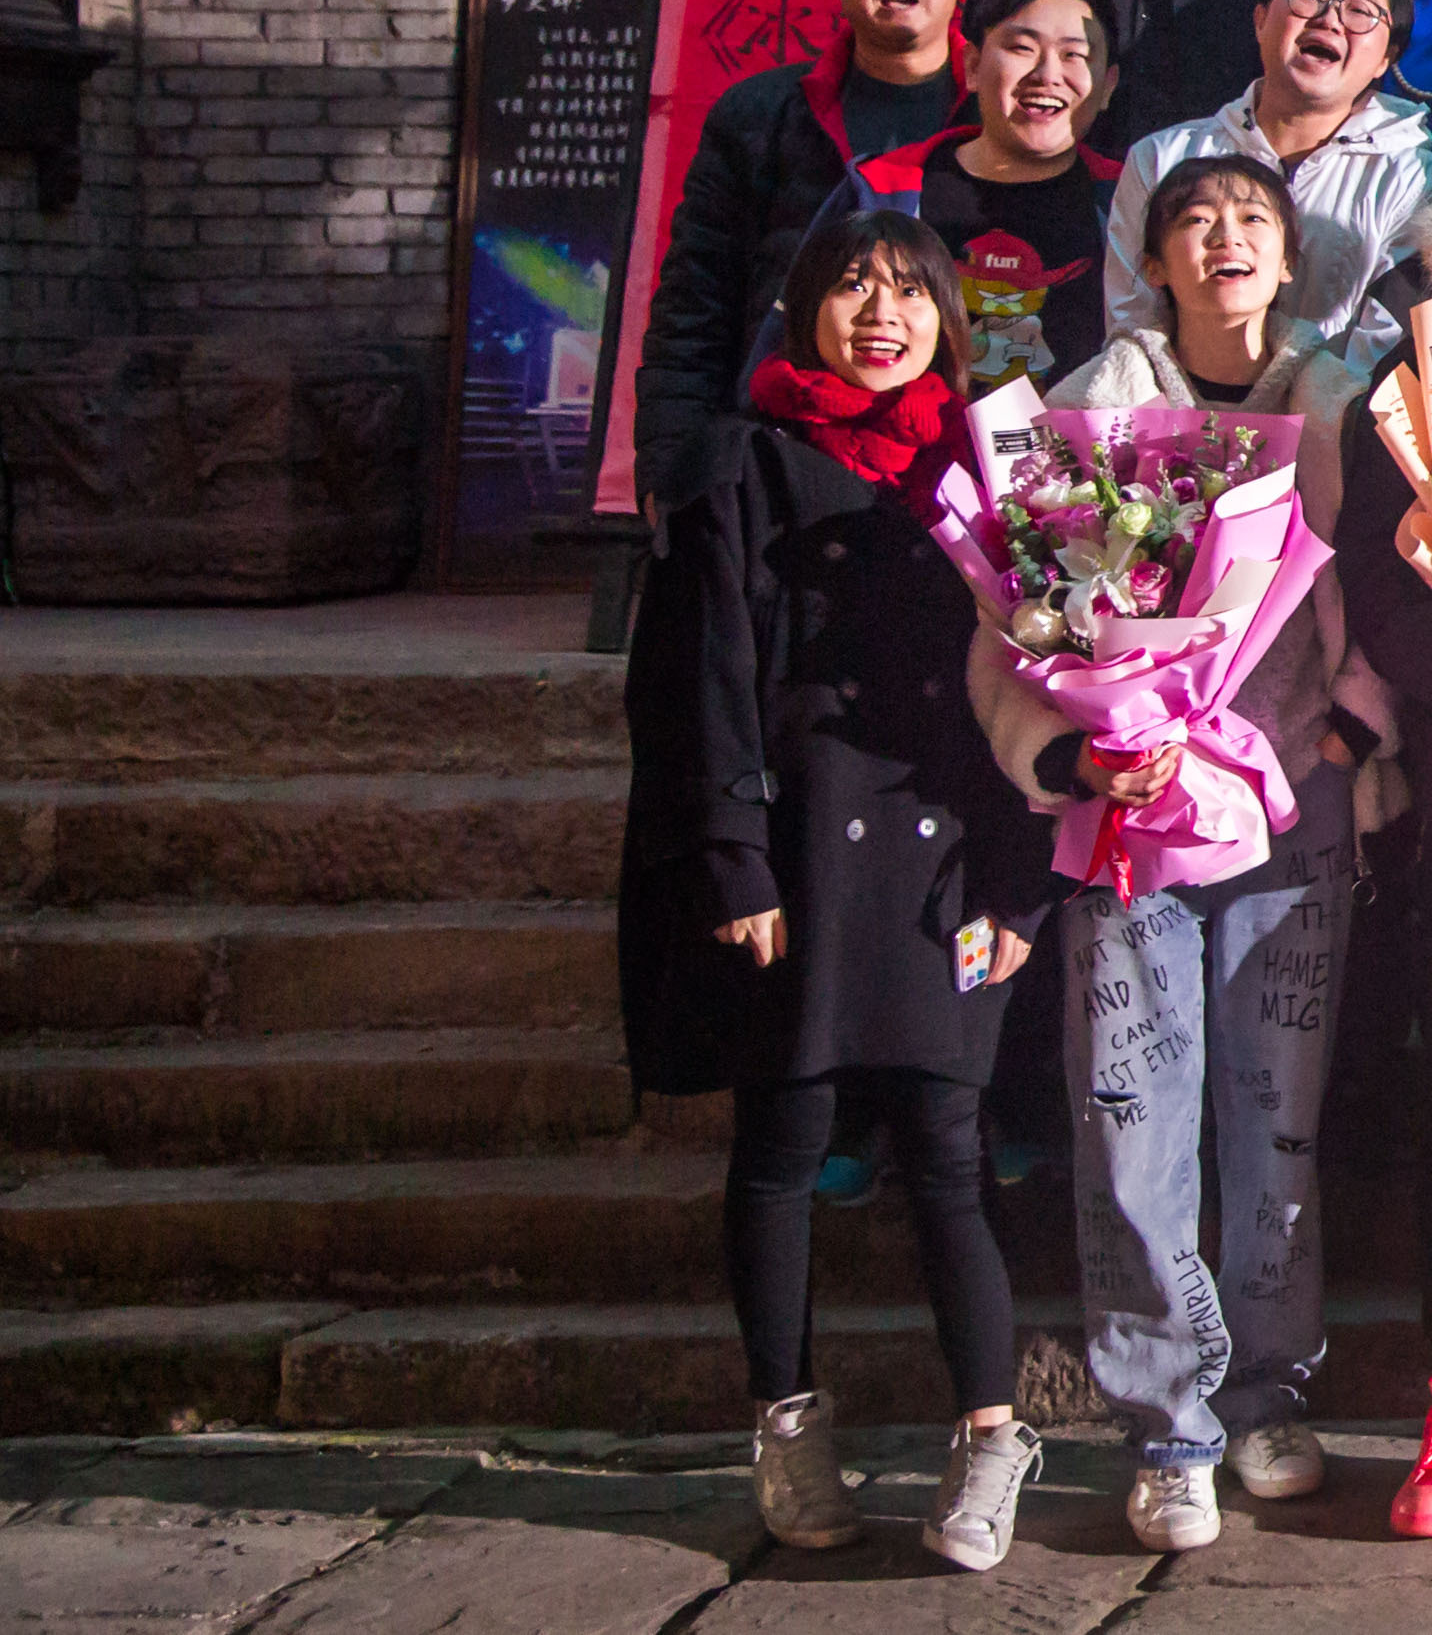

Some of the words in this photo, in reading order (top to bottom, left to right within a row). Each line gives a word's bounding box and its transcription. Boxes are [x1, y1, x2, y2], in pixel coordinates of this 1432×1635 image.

[985, 253, 1020, 269] fun
[1083, 979, 1130, 1025] AND
[1152, 964, 1169, 993] U
[1111, 1008, 1179, 1051] CAN'T
[1112, 1097, 1149, 1131] ME
